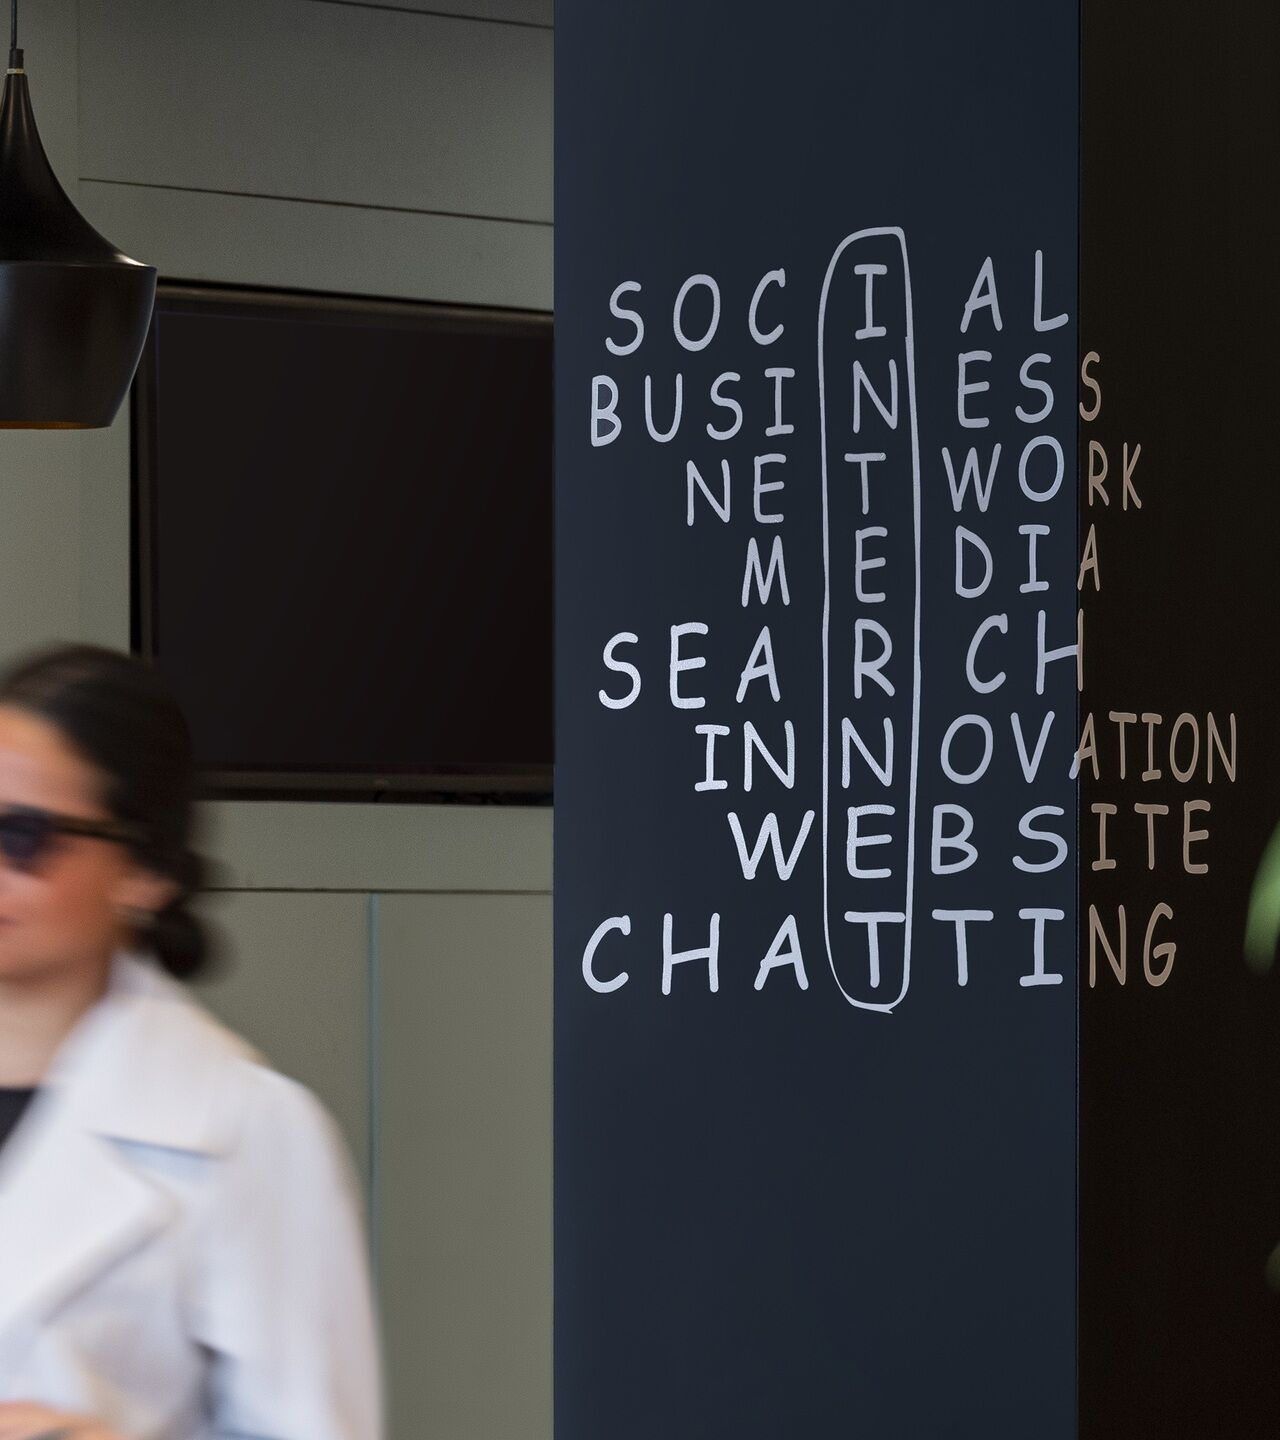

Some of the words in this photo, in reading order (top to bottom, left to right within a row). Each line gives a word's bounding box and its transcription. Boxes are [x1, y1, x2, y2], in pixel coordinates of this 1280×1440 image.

[605, 249, 1070, 357] SOCIAL
[590, 349, 1102, 447] BUSINESS
[686, 434, 1143, 526] NETWORK
[741, 522, 1101, 608] MEDIA
[597, 608, 1084, 710] SEARCH
[694, 711, 1237, 791] INNOVATION
[727, 800, 1211, 881] WEBSITE
[581, 901, 1177, 997] CHATTING
